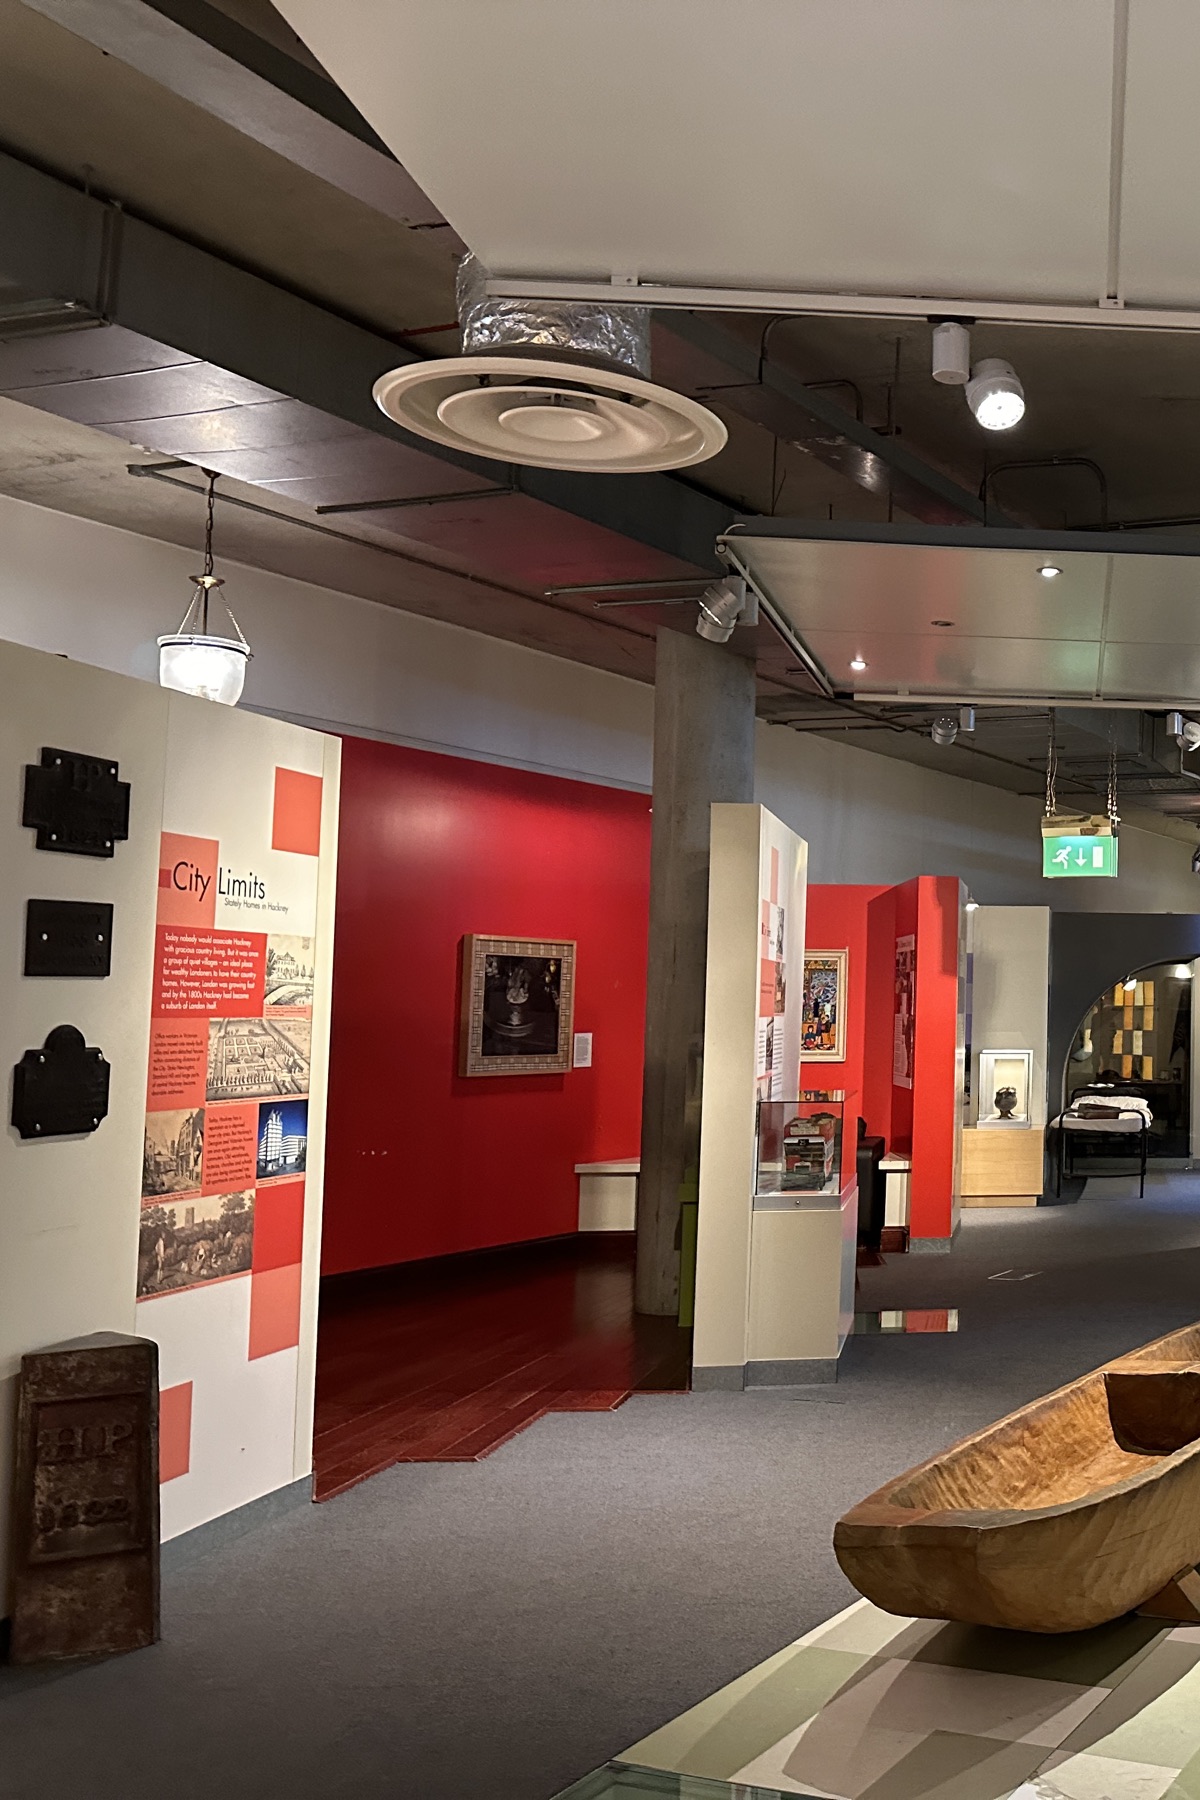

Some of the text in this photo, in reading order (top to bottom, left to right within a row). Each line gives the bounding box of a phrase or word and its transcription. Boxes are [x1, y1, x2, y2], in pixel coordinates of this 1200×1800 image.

[173, 861, 265, 902] City Limits
[224, 897, 241, 910] Stately
[244, 900, 260, 909] Homes
[267, 902, 289, 914] Hackney
[165, 933, 178, 943] Today
[180, 933, 197, 944] nobody
[198, 935, 212, 943] would
[233, 938, 251, 948] Hackney
[175, 947, 194, 955] gracious
[196, 948, 212, 956] country
[168, 958, 182, 966] group
[183, 956, 188, 964] of
[189, 958, 200, 967] quiet
[202, 957, 218, 967] villages
[241, 960, 253, 968] place
[171, 967, 188, 977] wealthy
[190, 968, 212, 977] Londoners
[219, 969, 229, 977] have
[240, 972, 256, 980] country
[229, 981, 246, 990] growing
[172, 990, 178, 1000] by
[188, 990, 202, 998] 1800s
[203, 991, 222, 1000] Hackney
[233, 991, 249, 999] become
[166, 1001, 181, 1009] suburb
[183, 1001, 188, 1009] of
[189, 1001, 205, 1009] London
